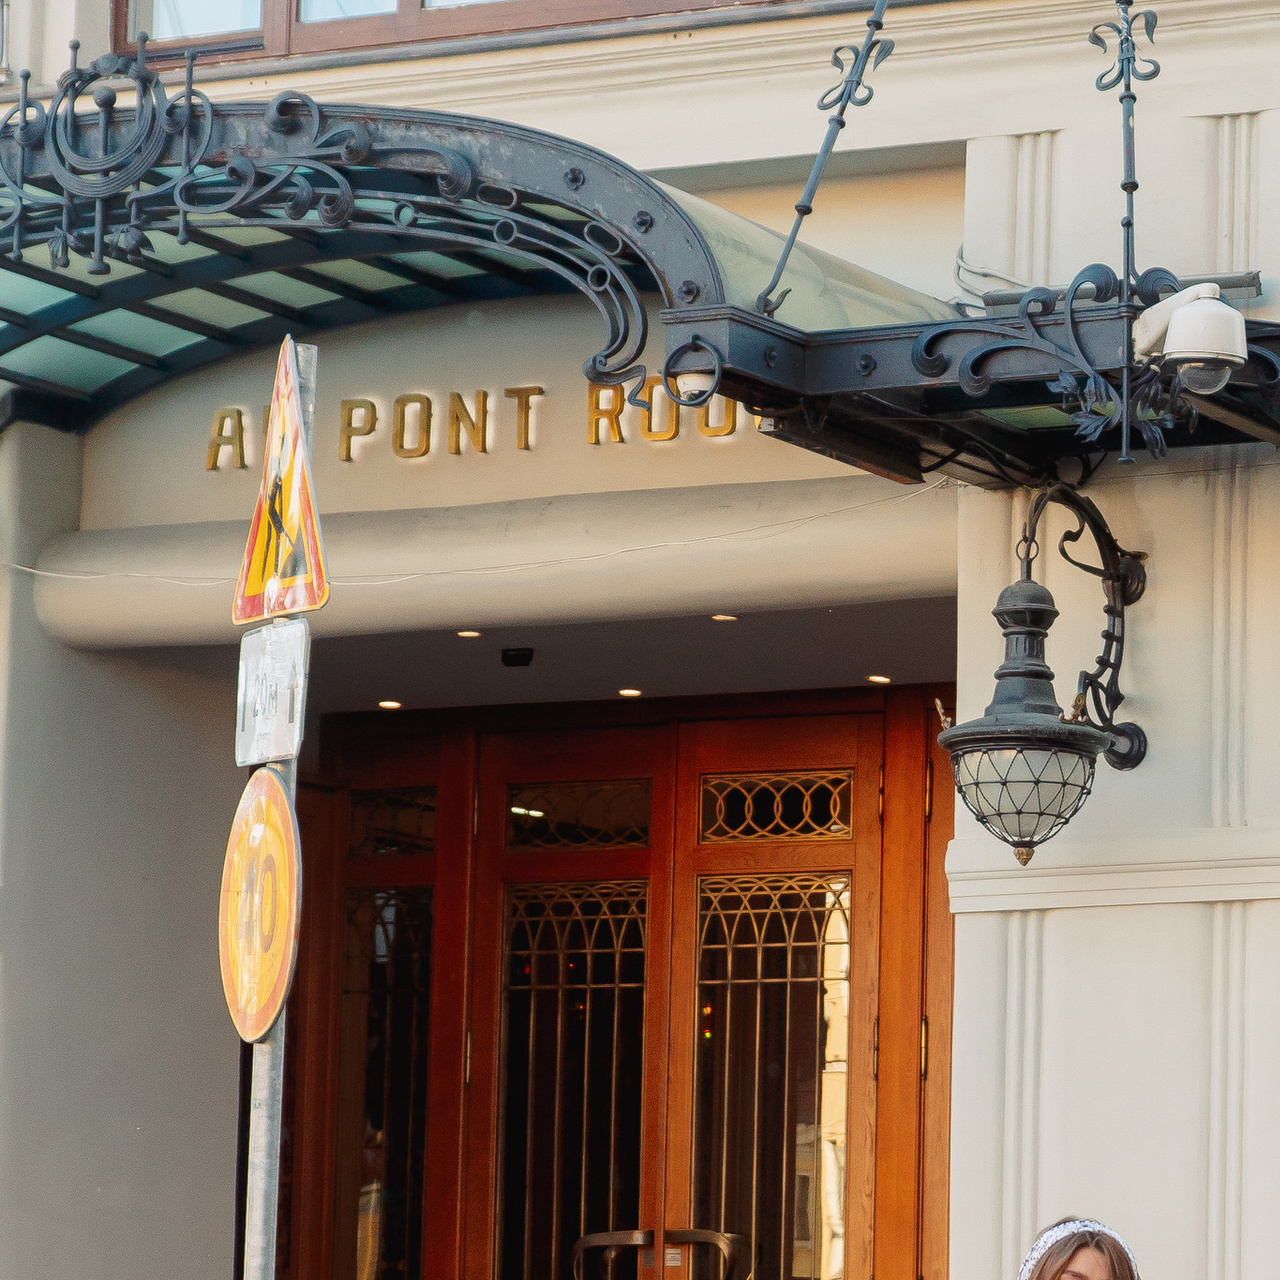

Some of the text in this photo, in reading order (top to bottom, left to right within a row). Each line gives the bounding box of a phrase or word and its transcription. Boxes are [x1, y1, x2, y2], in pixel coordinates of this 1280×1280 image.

[206, 375, 760, 471] A PONT ROU
[236, 853, 278, 957] 40
